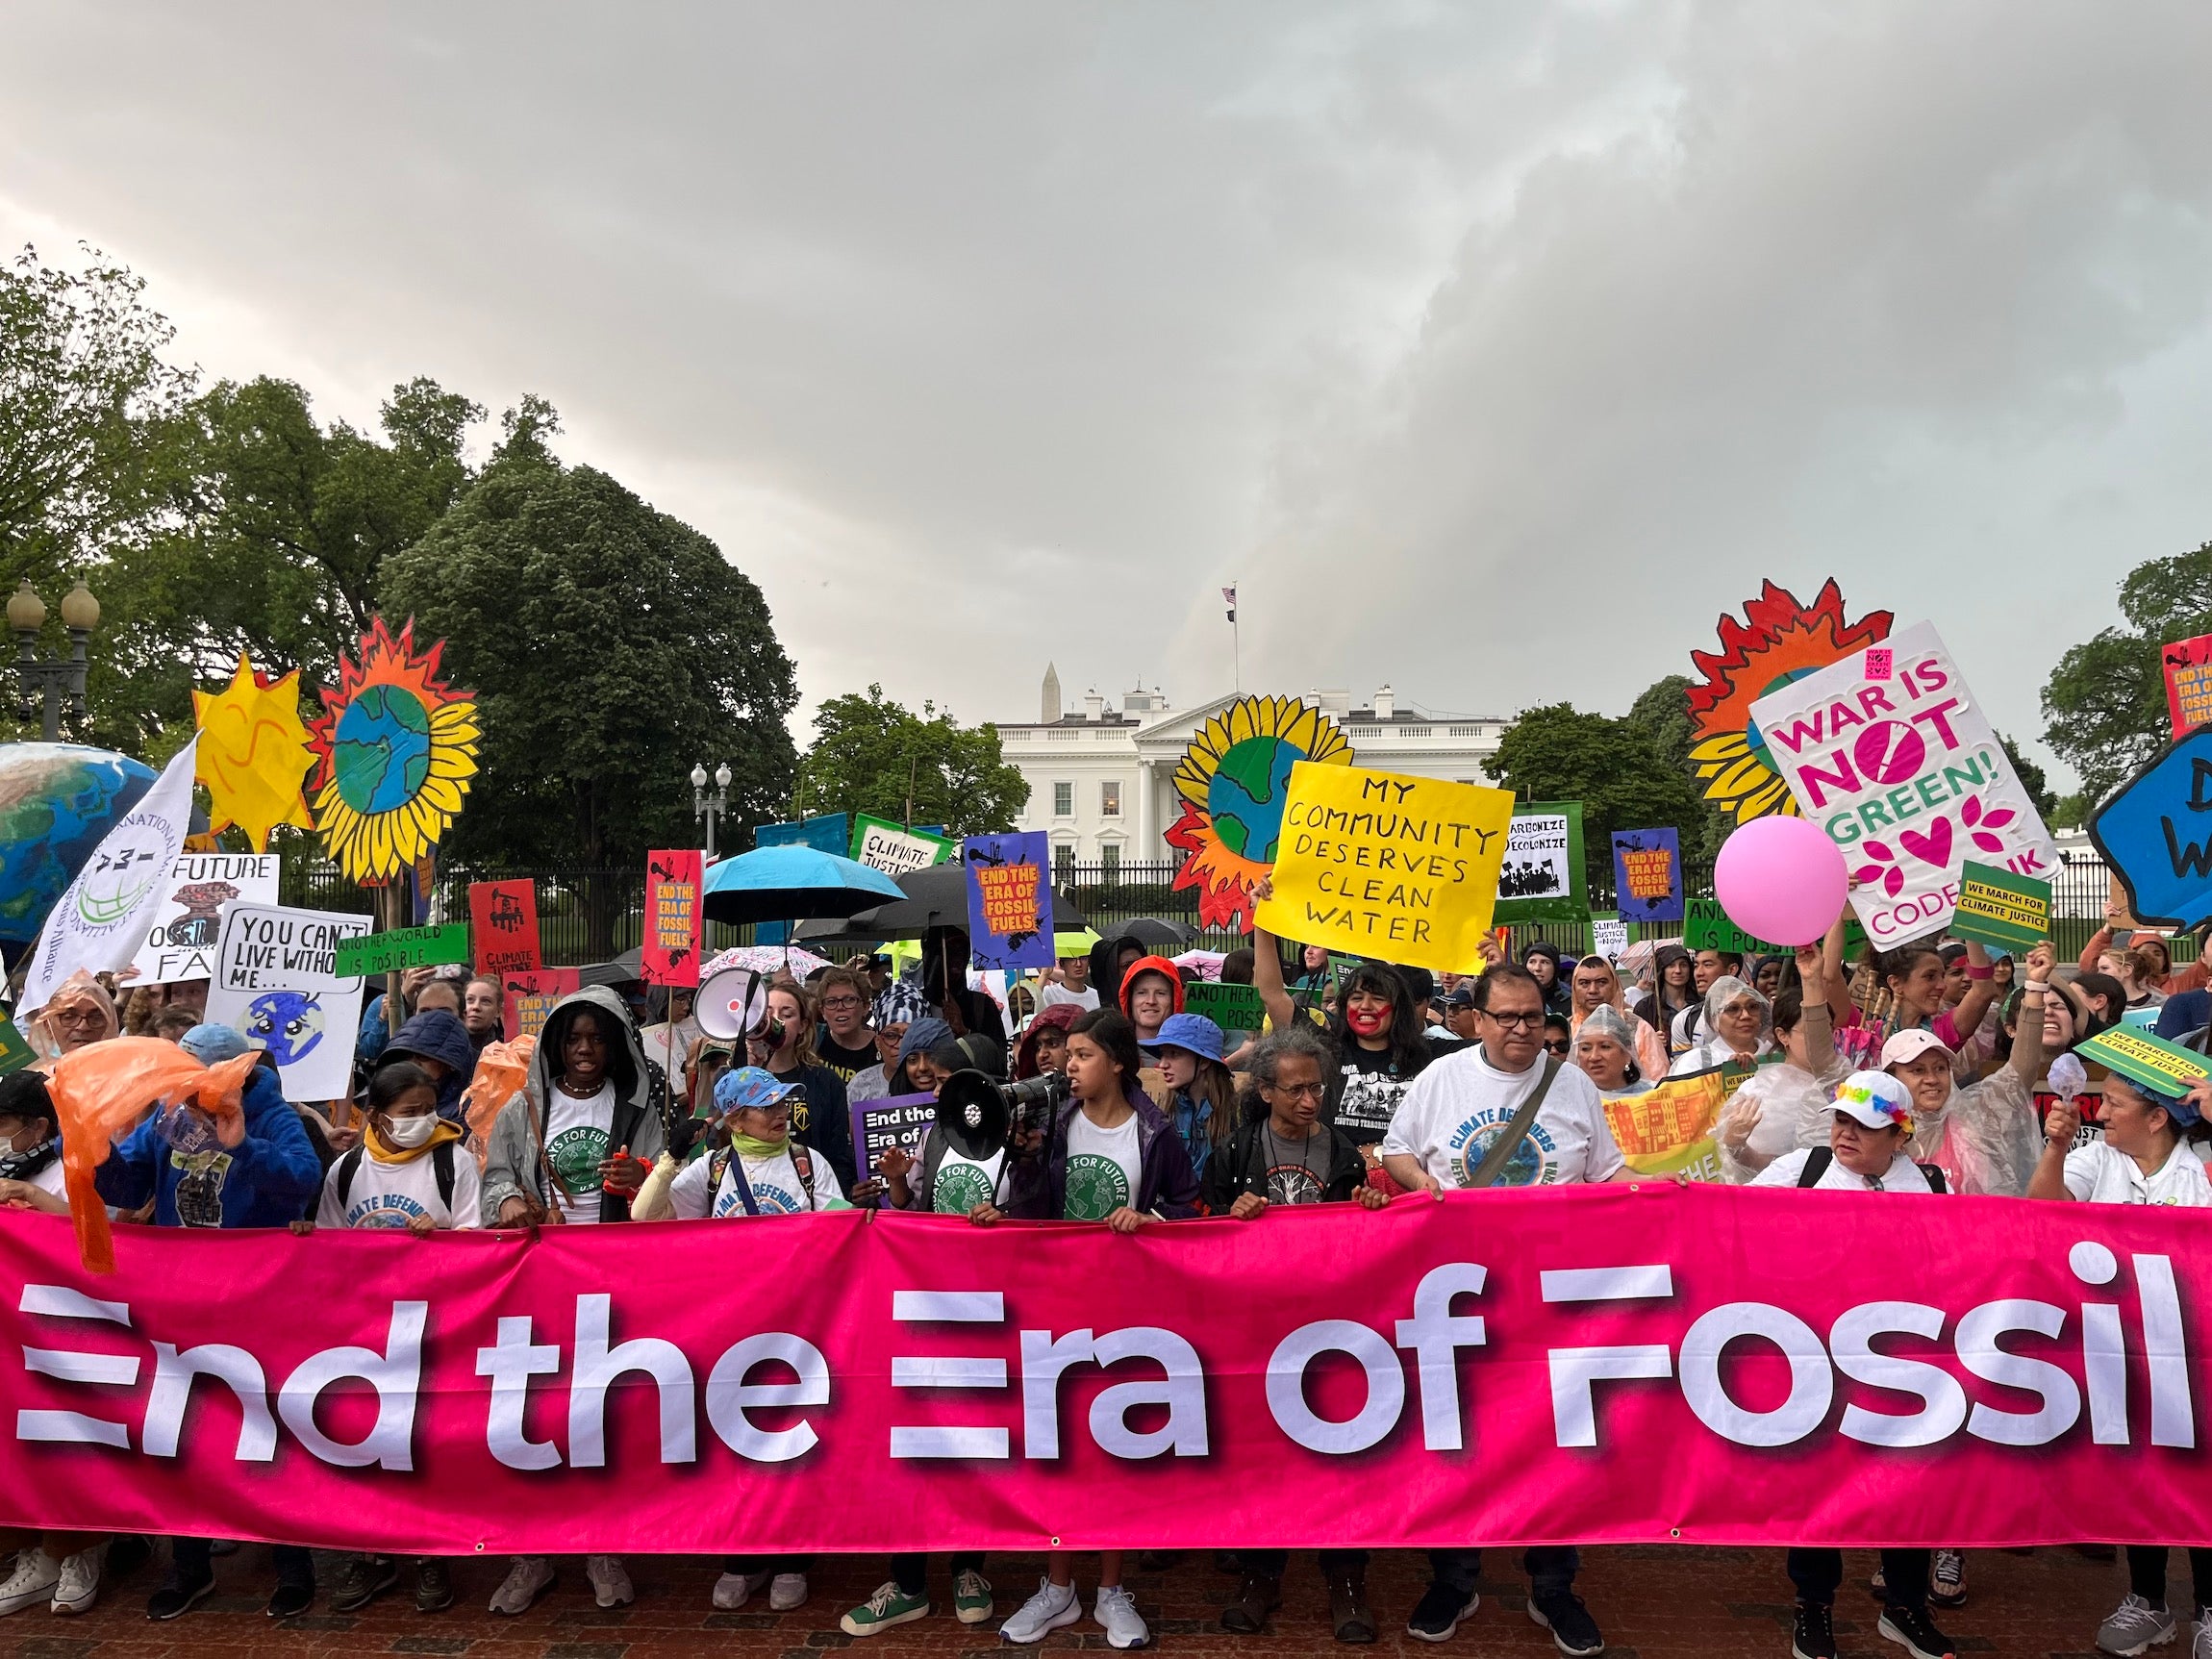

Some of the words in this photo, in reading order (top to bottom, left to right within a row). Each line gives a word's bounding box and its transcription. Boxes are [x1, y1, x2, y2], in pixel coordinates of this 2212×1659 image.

[2174, 669, 2196, 685] END
[2197, 666, 2212, 680] TH
[2178, 682, 2201, 697] ERA
[2202, 680, 2212, 692] O
[1772, 685, 1898, 754] WAR
[1898, 659, 1948, 701] IS
[2180, 692, 2212, 713] FOSSI
[1797, 697, 1960, 810] NOT
[1362, 777, 1416, 804] MY
[1825, 750, 1998, 844] GREEN!
[1289, 801, 1498, 855] COMMUNITY
[1509, 819, 1565, 834] ARBONIZE
[868, 835, 928, 866] CLIMATE
[1295, 834, 1468, 883] DESERVES
[1624, 854, 1647, 865] END
[1648, 852, 1670, 863] THE
[172, 856, 271, 881] FUTURE
[863, 852, 917, 875] JUSTIC
[1628, 865, 1652, 875] ERA
[1653, 865, 1668, 874] OF
[981, 869, 1009, 885] END
[1009, 867, 1038, 882] THE
[1629, 874, 1669, 886] FOSSIL
[657, 885, 675, 900] END
[676, 885, 694, 900] THE
[985, 885, 1014, 900] ERA
[1016, 883, 1035, 898] OF
[1318, 871, 1433, 908] CLEAN
[1633, 886, 1666, 896] FUELS
[1872, 848, 2046, 935] CODEK
[1968, 881, 1984, 894] WE
[1986, 884, 2022, 905] MARCH
[2024, 896, 2043, 910] FOR
[659, 900, 678, 916] ERA
[679, 900, 691, 916] OF
[987, 899, 1036, 917] FOSSIL
[1961, 898, 2005, 917] CLIMATE
[2008, 910, 2046, 927] JUSTICE
[242, 917, 293, 944] YOU
[658, 916, 691, 932] FOSSIL
[991, 915, 1034, 932] FUELS
[1306, 901, 1431, 943] WATER
[149, 919, 207, 947] OSSIL
[389, 926, 441, 943] WORLD
[660, 932, 689, 947] FUELS
[1594, 930, 1625, 939] JUSTICE
[1702, 931, 1720, 949] IS
[42, 929, 63, 984] Alliance
[234, 943, 277, 969] LIVE
[284, 949, 337, 974] WITHO
[349, 959, 362, 973] IS
[371, 949, 424, 971] POSIBLE
[486, 950, 534, 965] CLIMATE
[230, 968, 287, 989] ME...
[516, 998, 543, 1010] END
[1186, 986, 1254, 1003] ANOTHER
[520, 1012, 547, 1023] ERA
[1226, 1009, 1263, 1030] POSS
[2099, 1037, 2150, 1061] CLIMATE
[2150, 1060, 2187, 1078] JUSTI
[2114, 1032, 2131, 1043] WE
[2134, 1041, 2177, 1063] MARCH
[2178, 1061, 2202, 1075] FOR
[1726, 1077, 1737, 1086] WE
[866, 1109, 901, 1128] End
[904, 1106, 936, 1122] the
[563, 1129, 587, 1144] FOR
[589, 1130, 610, 1146] FUT
[867, 1133, 896, 1148] Era
[900, 1127, 919, 1144] of
[1449, 1108, 1495, 1150] CLIMATE
[1498, 1107, 1556, 1153] DEDERS
[945, 1166, 968, 1178] FOR
[968, 1169, 992, 1200] FUTUR
[1072, 1157, 1097, 1169] FOR
[1099, 1160, 1127, 1201] FUTURE
[383, 1194, 425, 1218] DEFEND
[752, 1182, 801, 1214] DEFENDE
[16, 1283, 428, 1470] End
[475, 1293, 829, 1470] the
[890, 1290, 1208, 1459] Era
[1265, 1262, 1487, 1453] of
[1540, 1241, 2195, 1448] Fossil
